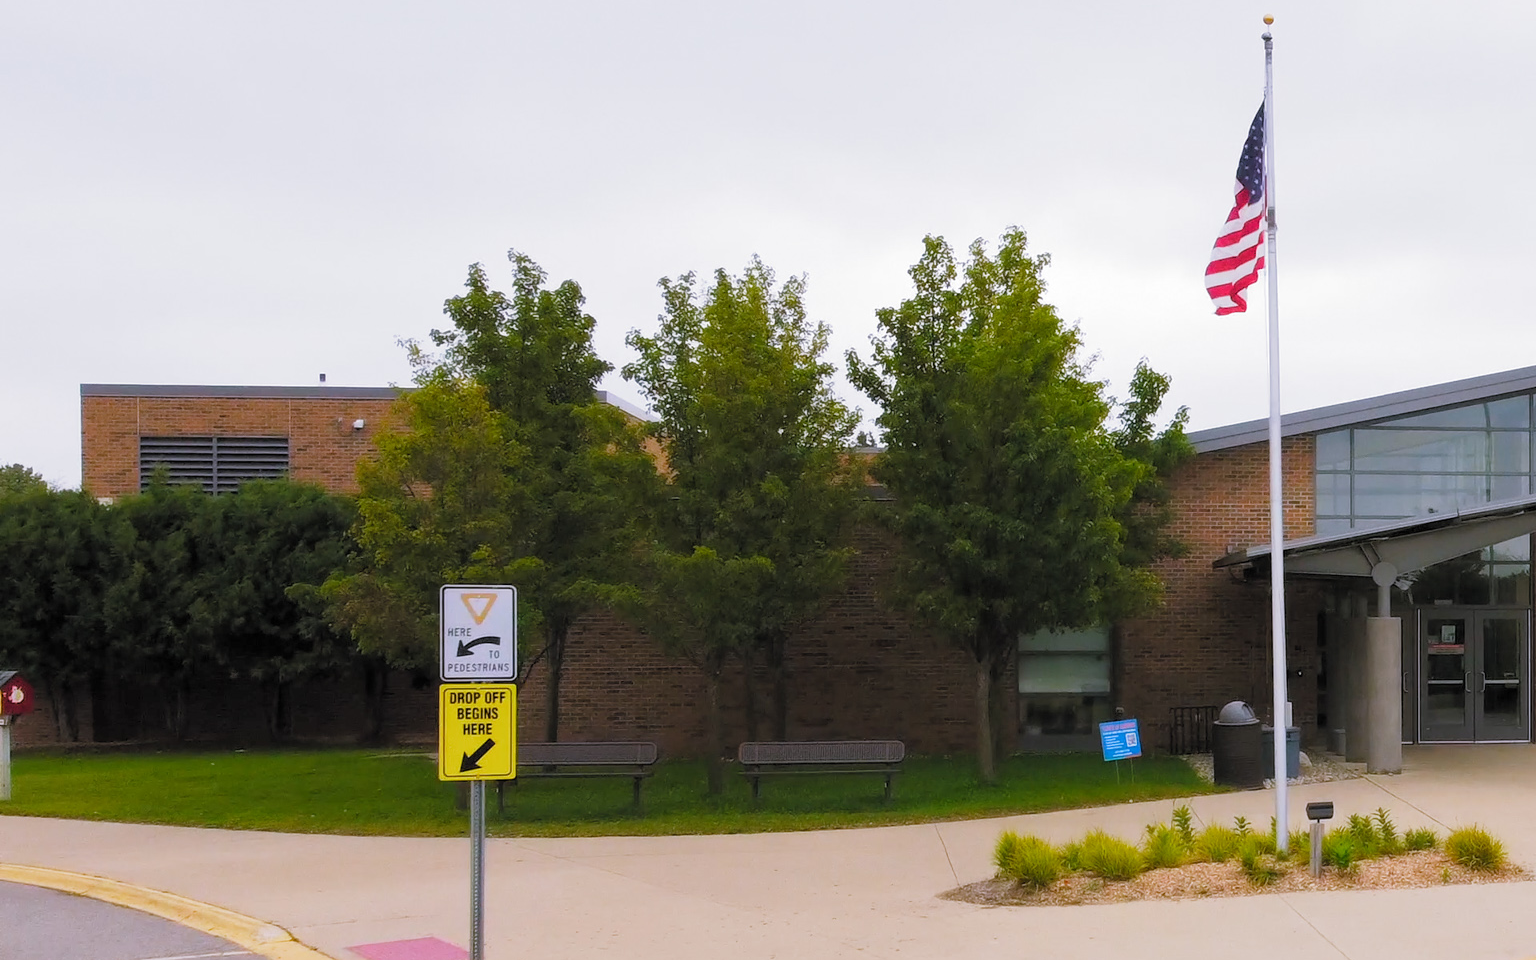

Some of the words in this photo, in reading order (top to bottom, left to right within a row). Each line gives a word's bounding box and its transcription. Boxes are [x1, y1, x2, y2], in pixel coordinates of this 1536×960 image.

[447, 627, 472, 637] HERE
[489, 650, 500, 659] TO
[447, 663, 509, 672] PEDESTRIANS
[450, 692, 480, 704] DROP
[485, 692, 506, 704] OFF
[457, 708, 499, 720] BEGINS
[463, 723, 492, 735] HERE
